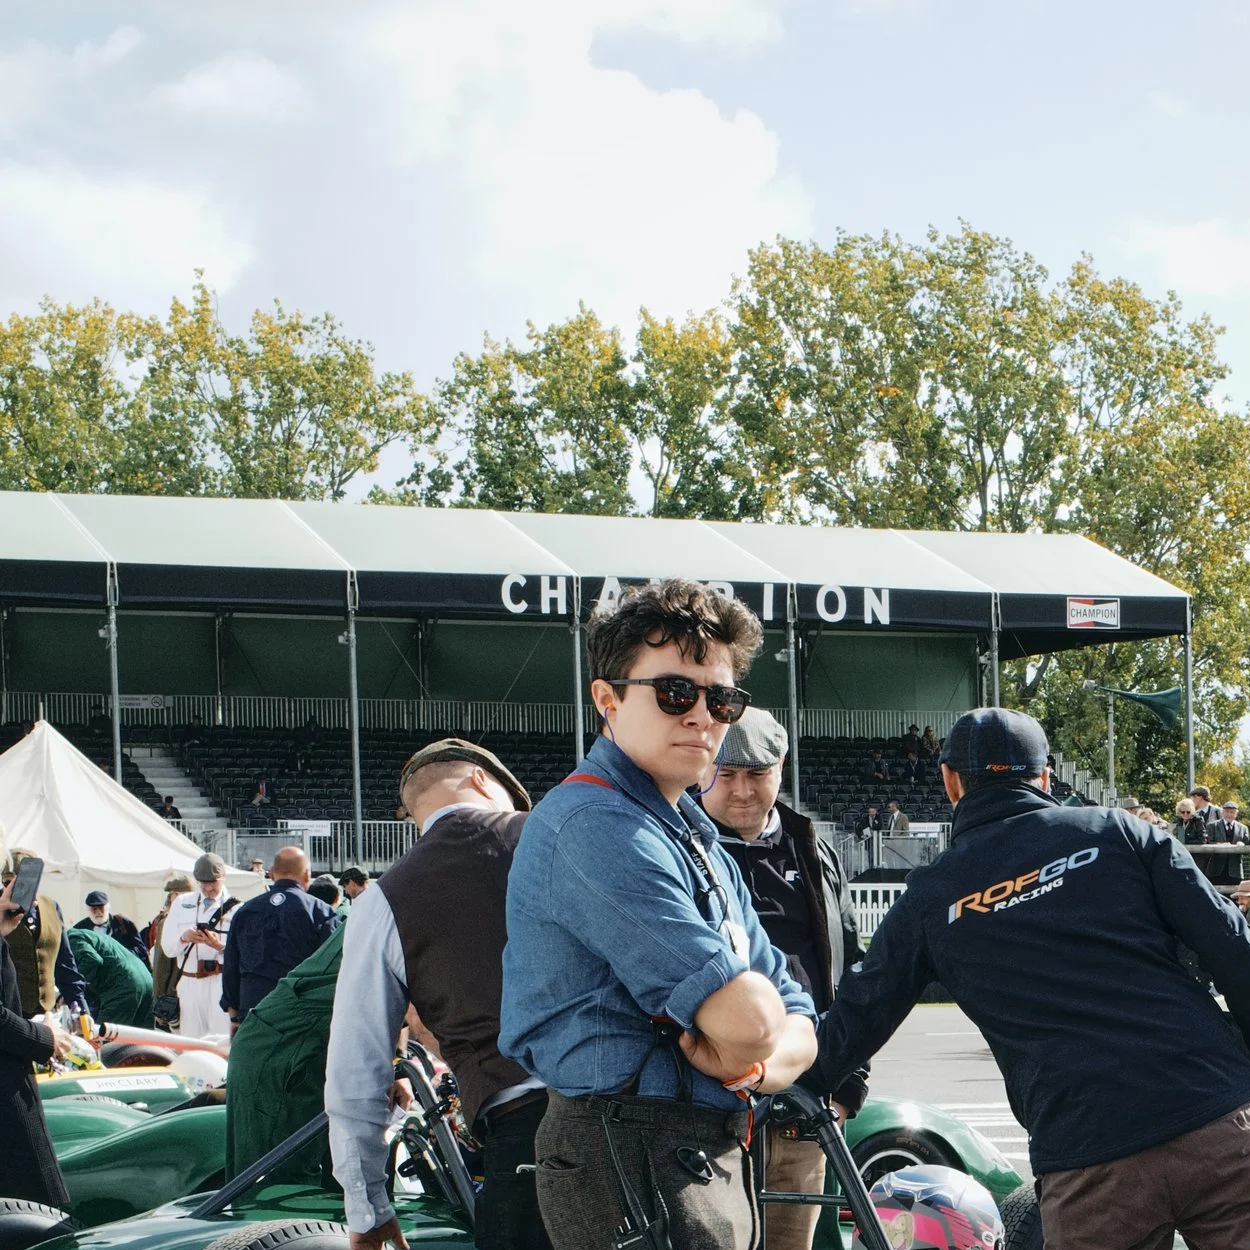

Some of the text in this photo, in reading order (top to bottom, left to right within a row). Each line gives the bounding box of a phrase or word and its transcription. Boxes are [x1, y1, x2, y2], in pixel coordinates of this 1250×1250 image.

[501, 573, 890, 625] CHAION
[1070, 608, 1116, 619] CHAMPION
[691, 852, 708, 876] STAFF
[953, 846, 1100, 922] ROFGO
[993, 876, 1064, 913] RACING
[96, 1077, 159, 1089] Jim CLARK
